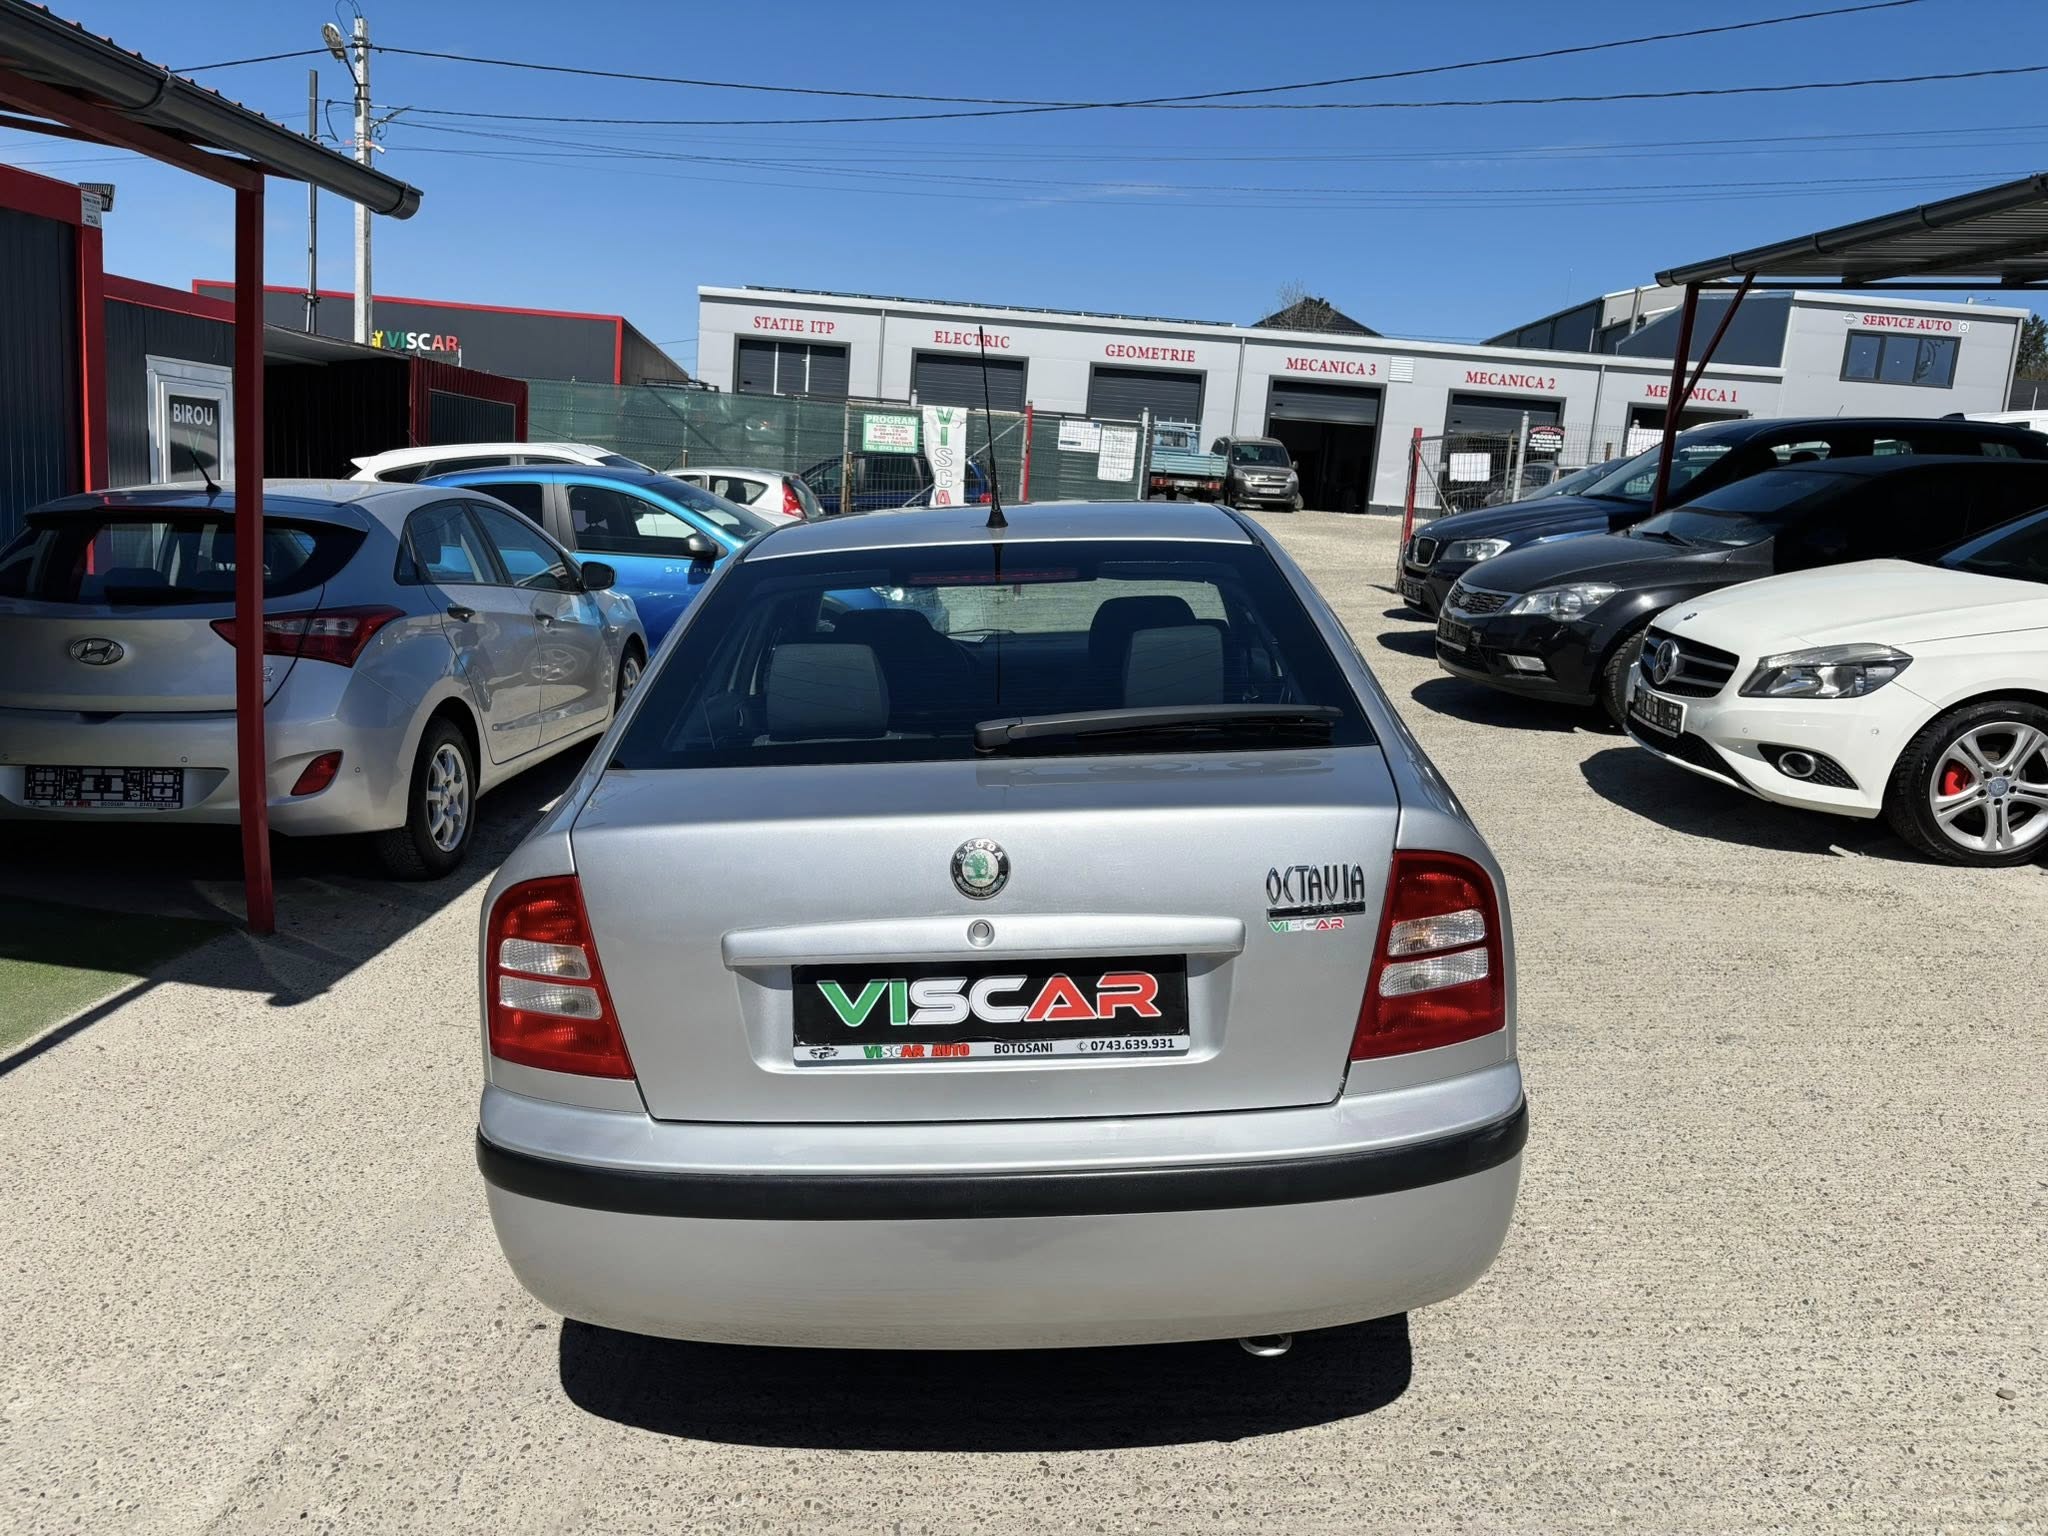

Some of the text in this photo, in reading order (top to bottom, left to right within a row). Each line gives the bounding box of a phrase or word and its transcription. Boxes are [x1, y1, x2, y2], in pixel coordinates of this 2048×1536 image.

[753, 315, 835, 335] STATIE ITP
[1862, 314, 1952, 332] SERVICE AUTO
[385, 331, 458, 351] VISCAR
[934, 330, 1010, 349] ELECTRIC
[1105, 344, 1196, 362] GEOMETRIE
[1285, 357, 1377, 376] MECANICA 3
[1465, 371, 1556, 390] MECANICA 2
[1645, 384, 1737, 403] MENICA 1
[173, 403, 213, 426] BIROU
[866, 415, 917, 425] PROGRAM
[1266, 864, 1365, 905] OCTAVIA
[1267, 917, 1345, 933] VISCAR
[816, 971, 1163, 1028] VISCAR
[863, 1038, 1175, 1059] VISCAR AUTO BOTOSANI 0743.639.931
